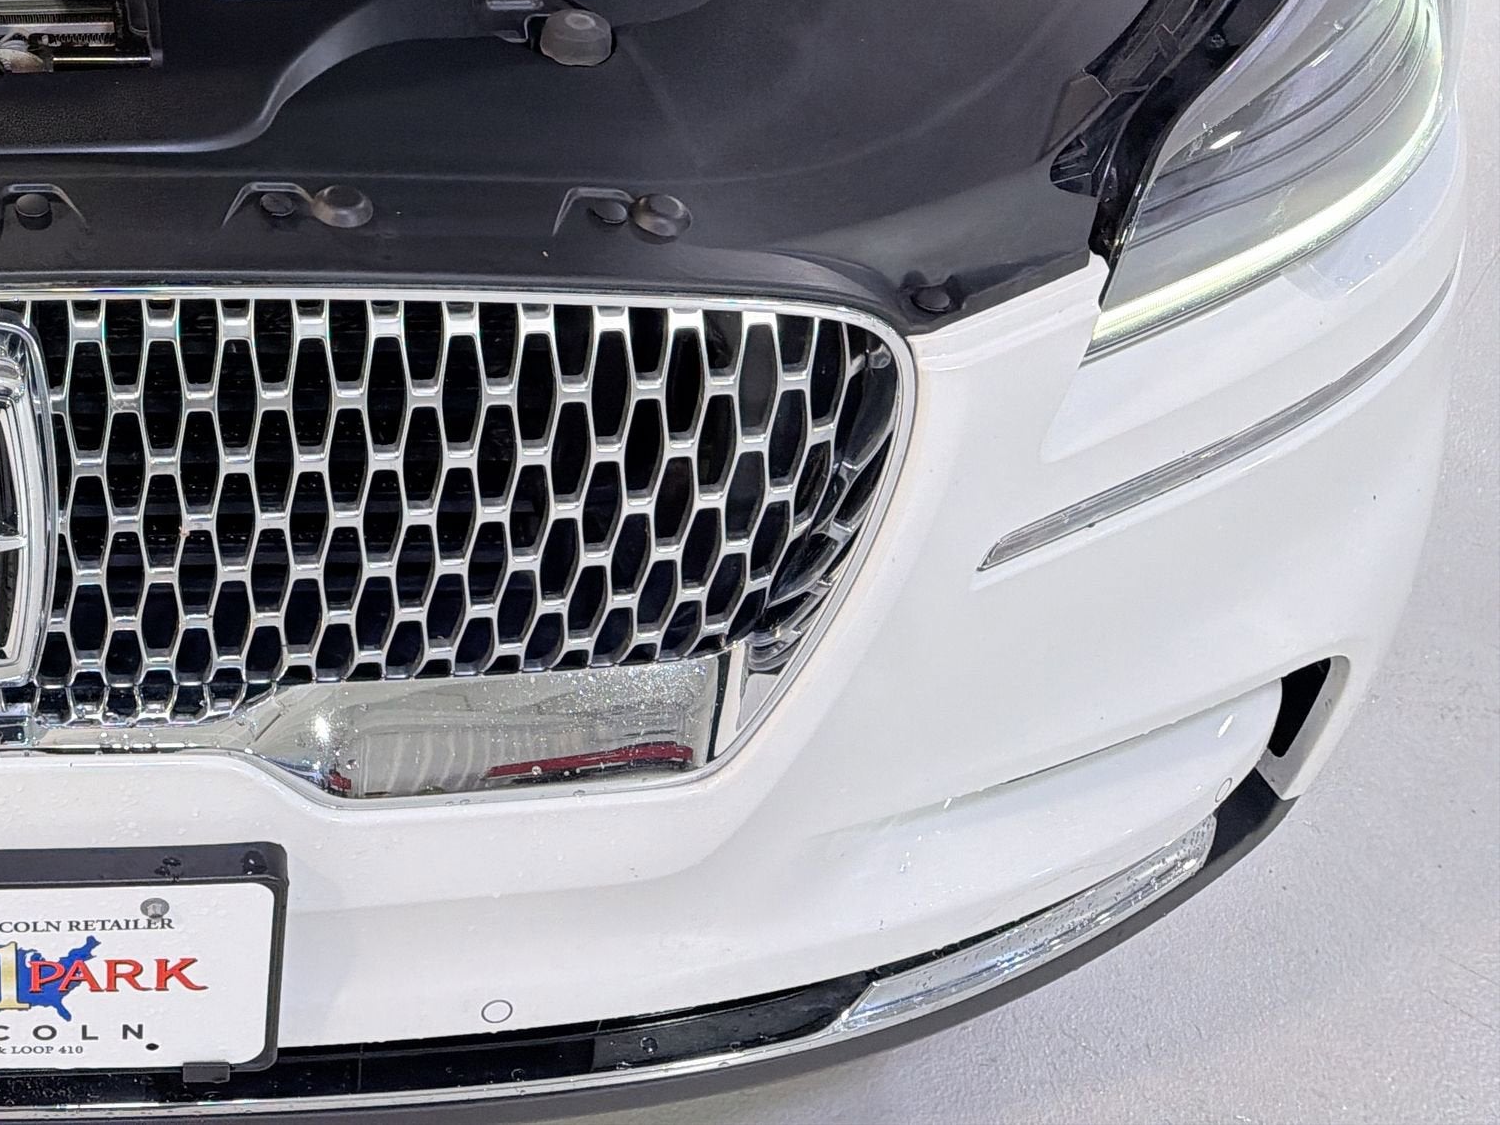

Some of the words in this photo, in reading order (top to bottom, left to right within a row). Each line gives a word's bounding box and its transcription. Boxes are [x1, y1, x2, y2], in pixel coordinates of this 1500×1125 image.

[68, 917, 175, 933] RETAILER
[28, 957, 209, 993] PARK
[11, 1045, 54, 1055] LOOP
[58, 1045, 84, 1055] 410
